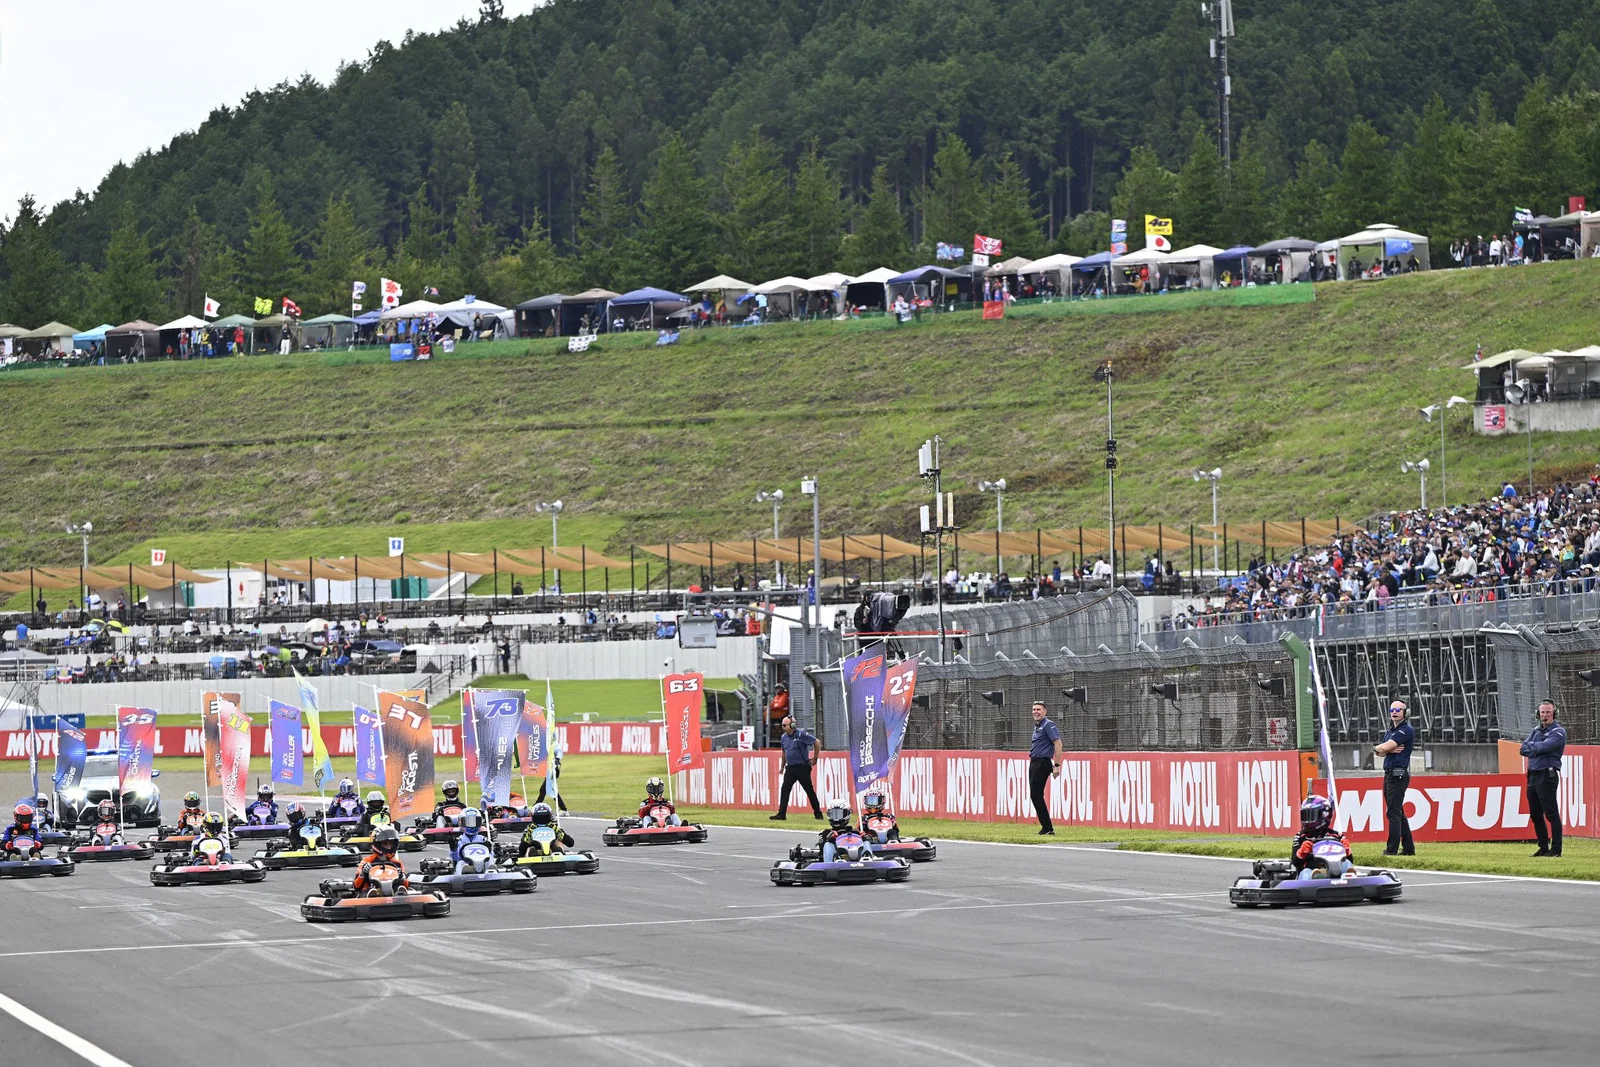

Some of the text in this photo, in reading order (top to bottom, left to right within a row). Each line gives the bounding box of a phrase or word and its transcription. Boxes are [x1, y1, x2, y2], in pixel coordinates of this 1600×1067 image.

[669, 678, 699, 694] 63
[851, 655, 884, 683] 72
[890, 670, 914, 695] 23
[122, 714, 154, 726] 35
[228, 714, 250, 733] 11
[580, 726, 612, 752] MOTUL
[621, 727, 652, 752] MOTUL
[865, 695, 874, 766] BEZZECCHI
[712, 757, 735, 804] MOTUL
[743, 757, 770, 805] MOTUL
[900, 756, 935, 813] MOTUL
[946, 757, 984, 815] MOTUL
[1050, 759, 1093, 821] MOTUL
[1107, 760, 1154, 825] MOTUL
[1169, 760, 1220, 828] MOTUL
[1237, 760, 1291, 830] MOTUL
[1556, 755, 1586, 827] TUL
[873, 819, 889, 827] 23
[1333, 786, 1531, 833] MOTUL
